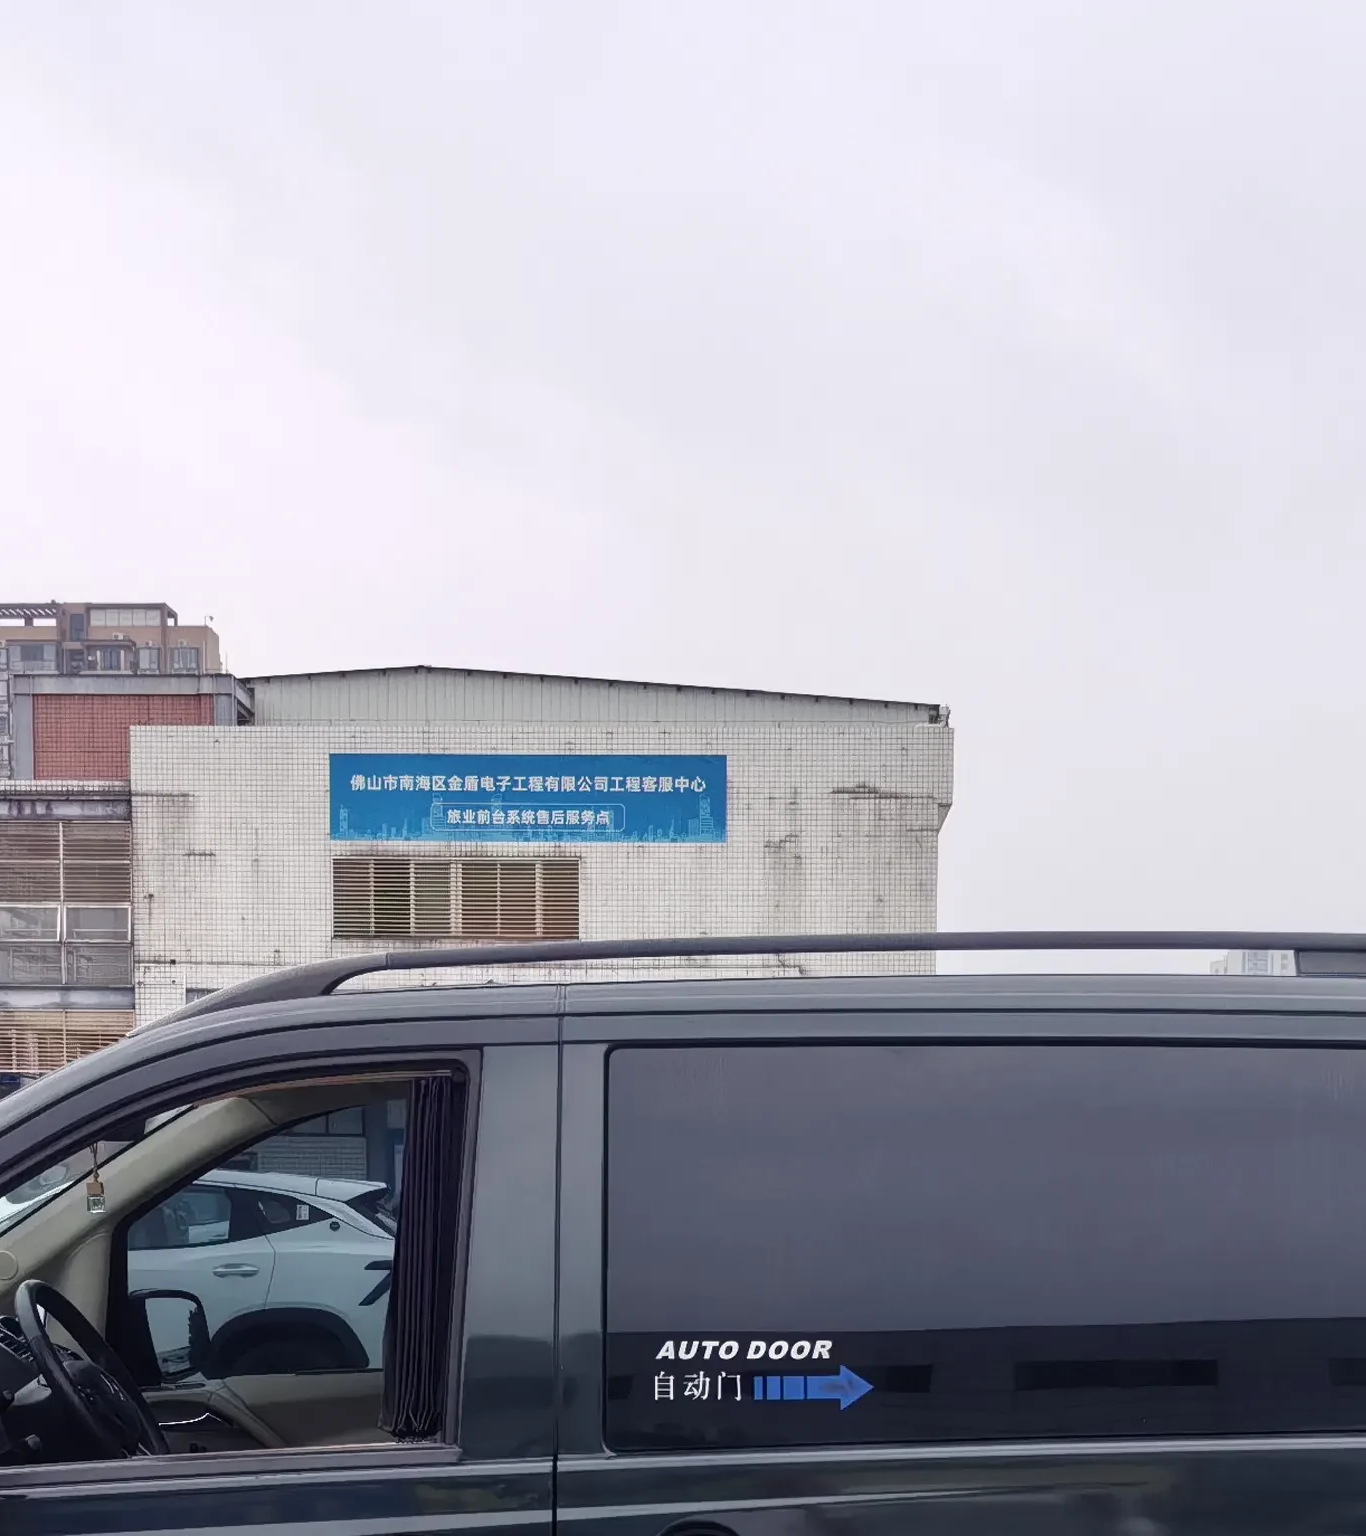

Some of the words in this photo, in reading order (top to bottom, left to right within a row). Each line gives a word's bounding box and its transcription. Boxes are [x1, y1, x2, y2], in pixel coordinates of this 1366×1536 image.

[350, 774, 707, 793] 佛山市南海区金盾电子工程有限公司工程客服中心
[446, 809, 611, 826] 旅业前台系统售后服务点
[655, 1340, 739, 1360] AUTO
[746, 1340, 833, 1360] DOOR
[654, 1371, 742, 1401] 自动门
